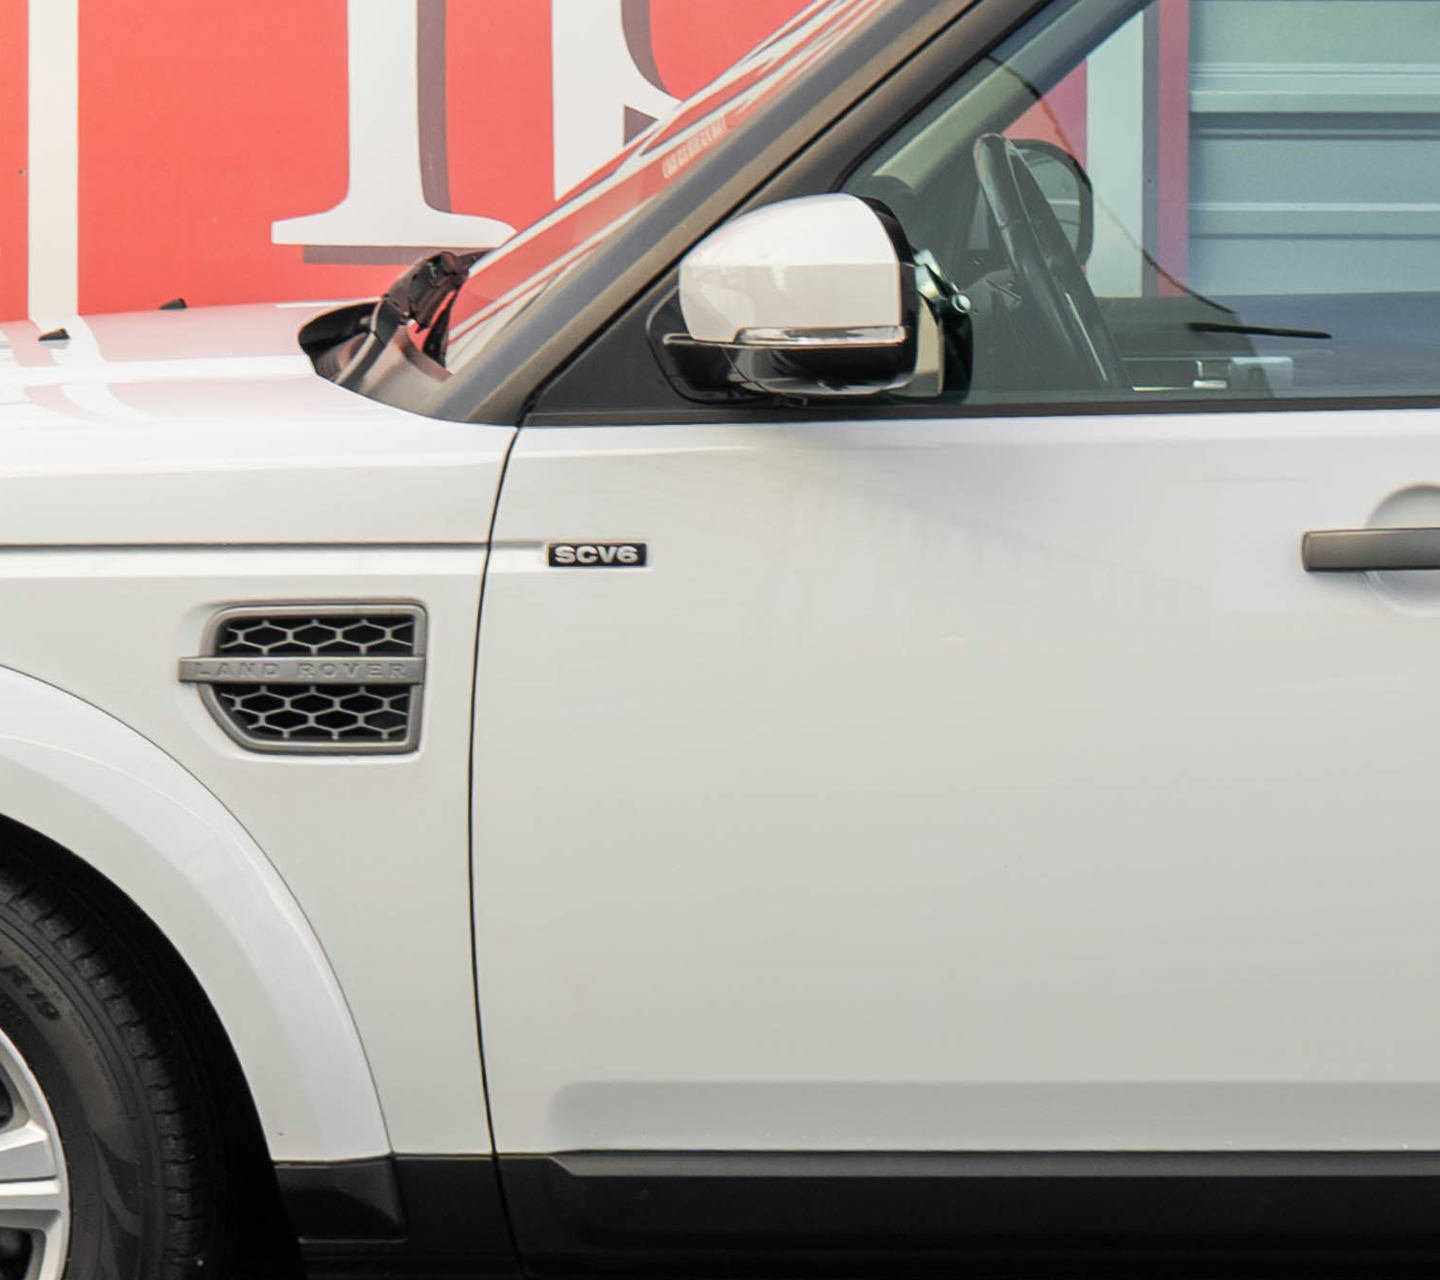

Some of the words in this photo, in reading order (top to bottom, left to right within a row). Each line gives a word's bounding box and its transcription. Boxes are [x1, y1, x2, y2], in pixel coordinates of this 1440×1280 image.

[554, 545, 639, 564] SCV6
[195, 662, 281, 680] LAND
[296, 662, 408, 680] ROVER
